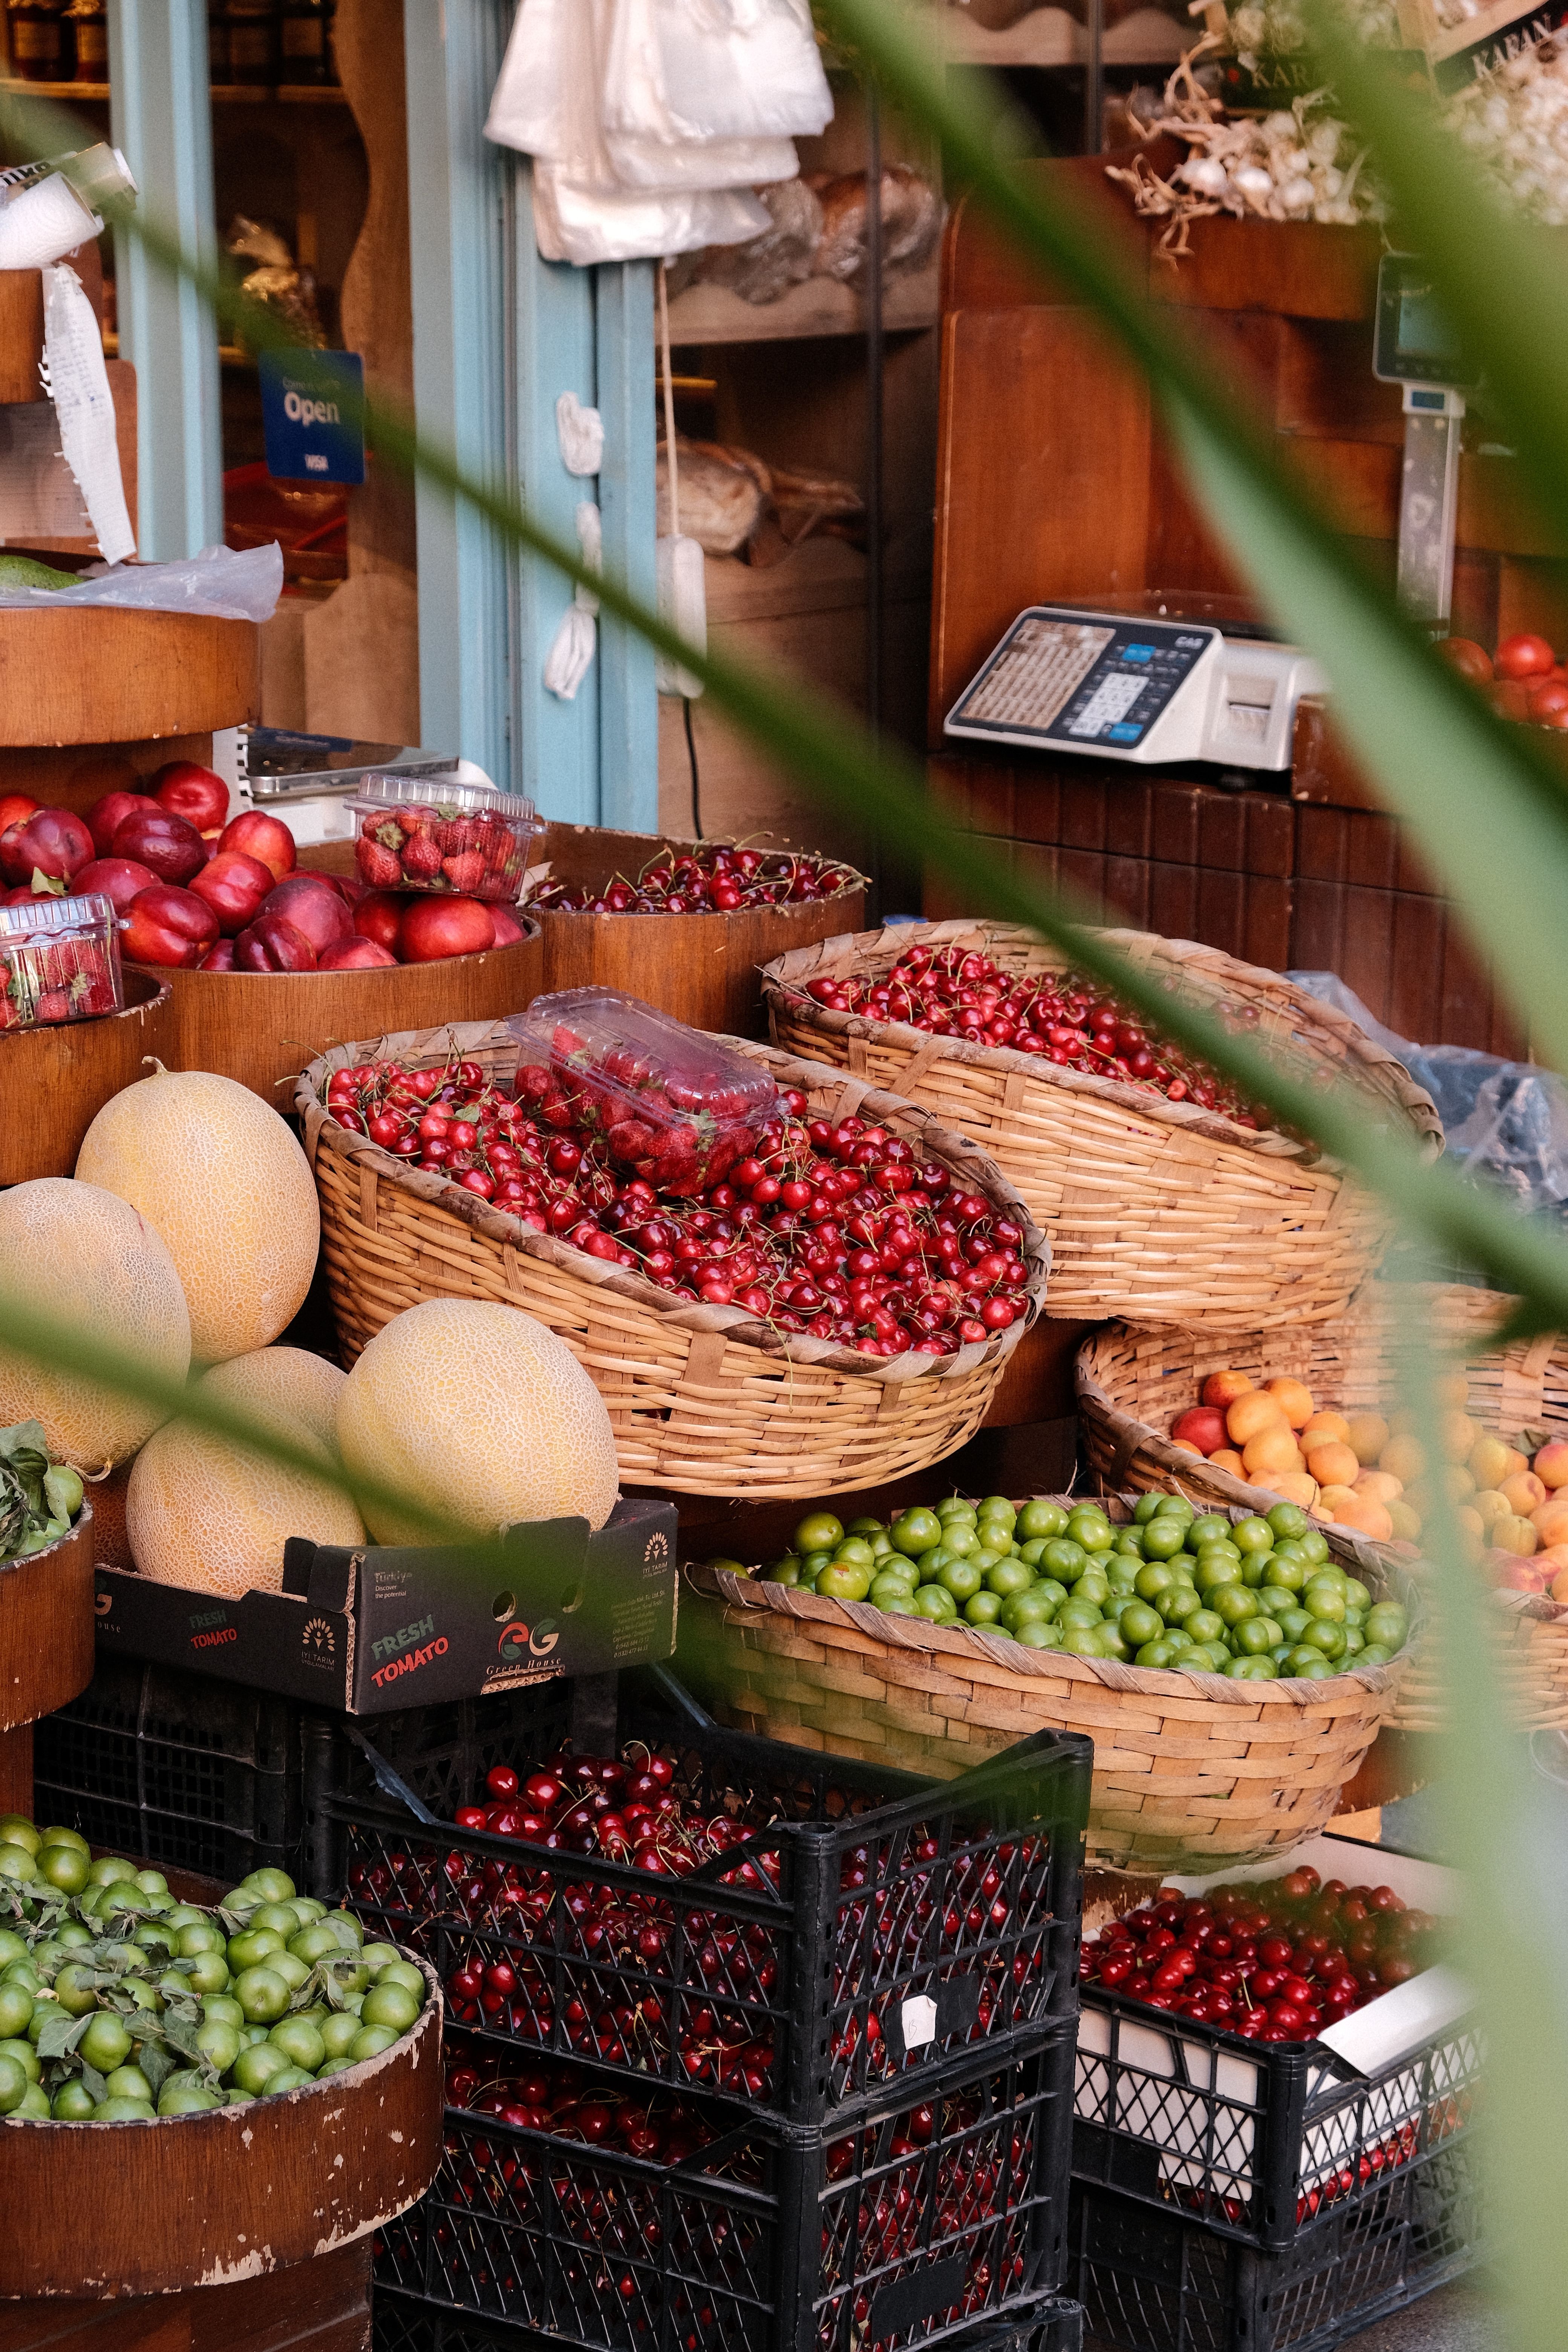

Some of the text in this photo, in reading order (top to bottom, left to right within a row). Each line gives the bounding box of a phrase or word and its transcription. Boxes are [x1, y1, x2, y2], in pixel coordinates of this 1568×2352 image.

[284, 390, 340, 428] Open
[652, 1561, 668, 1571] TARIM
[384, 1591, 407, 1599] potential
[98, 1622, 121, 1632] ouse
[188, 1609, 226, 1628] FRESH
[191, 1628, 237, 1649] TOMATO
[371, 1614, 434, 1660] FRESH
[302, 1659, 334, 1671] UYGULAMALARI
[313, 1654, 335, 1666] TARIM
[371, 1637, 449, 1687] TOMATO
[486, 1658, 561, 1675] Green House
